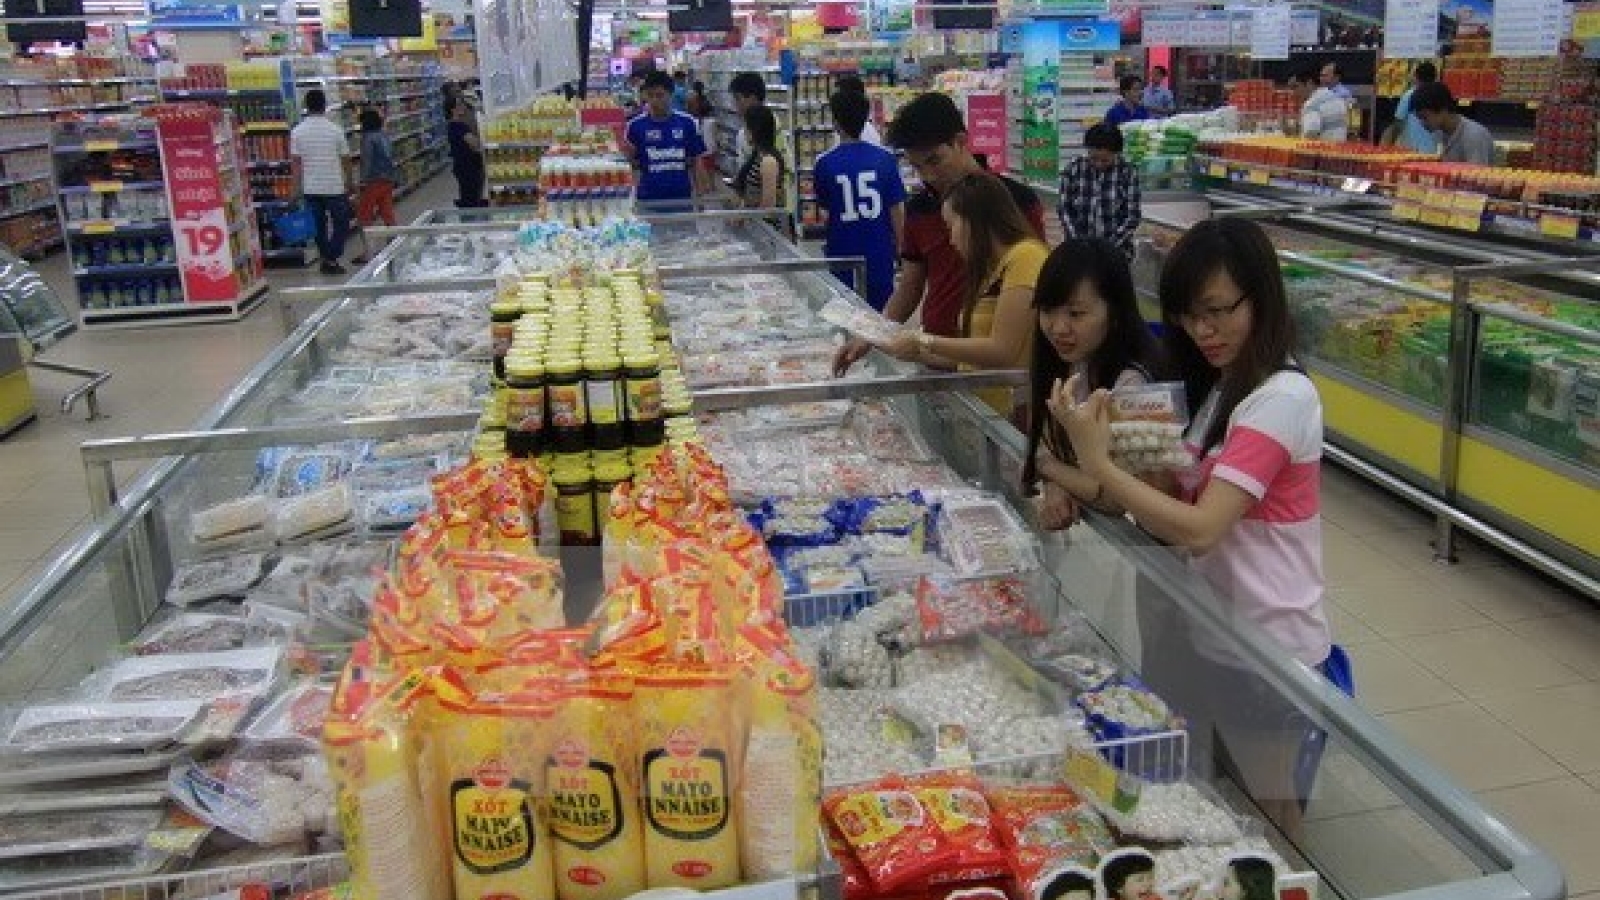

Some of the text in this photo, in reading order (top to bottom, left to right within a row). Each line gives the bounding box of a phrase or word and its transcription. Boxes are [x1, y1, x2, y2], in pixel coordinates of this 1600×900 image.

[835, 170, 882, 222] 15
[181, 226, 224, 256] 19
[661, 781, 713, 798] MAYO
